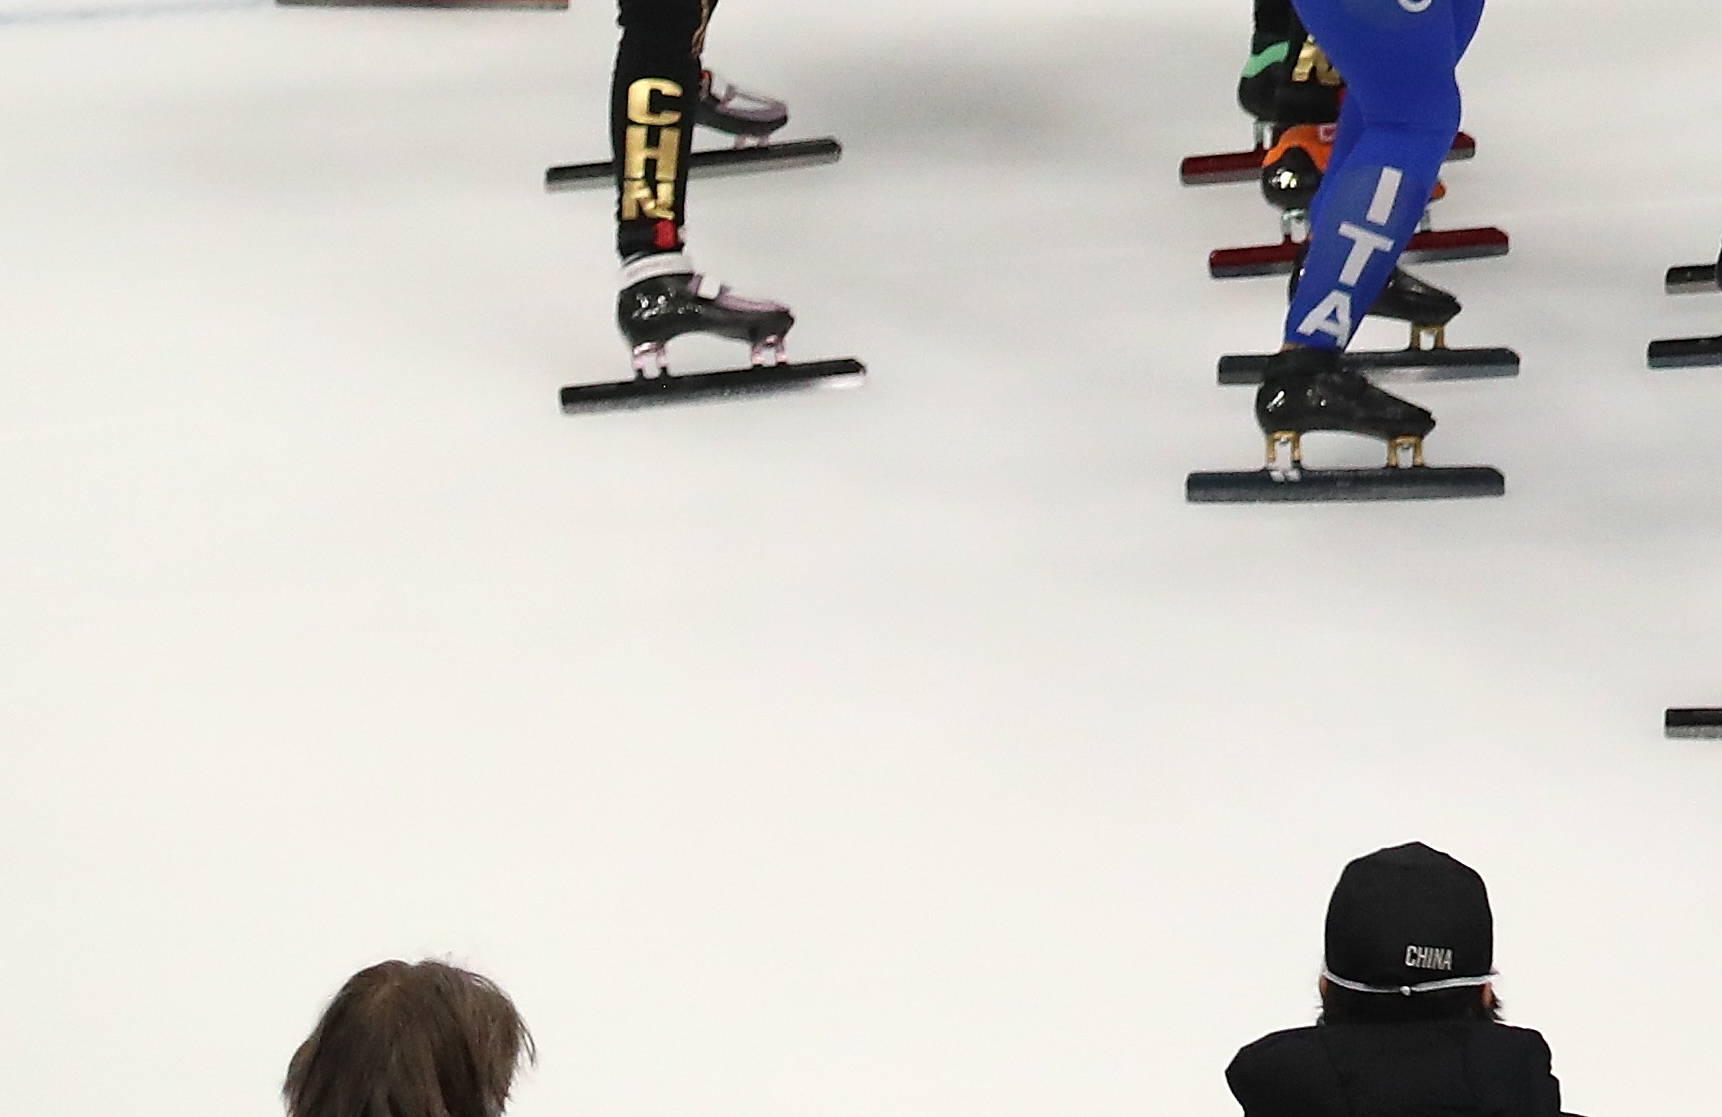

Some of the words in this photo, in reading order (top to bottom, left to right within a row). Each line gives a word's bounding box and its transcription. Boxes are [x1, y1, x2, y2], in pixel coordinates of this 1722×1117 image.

[621, 77, 683, 221] CHN
[1296, 166, 1403, 348] ITA
[1405, 945, 1453, 971] CHINA
